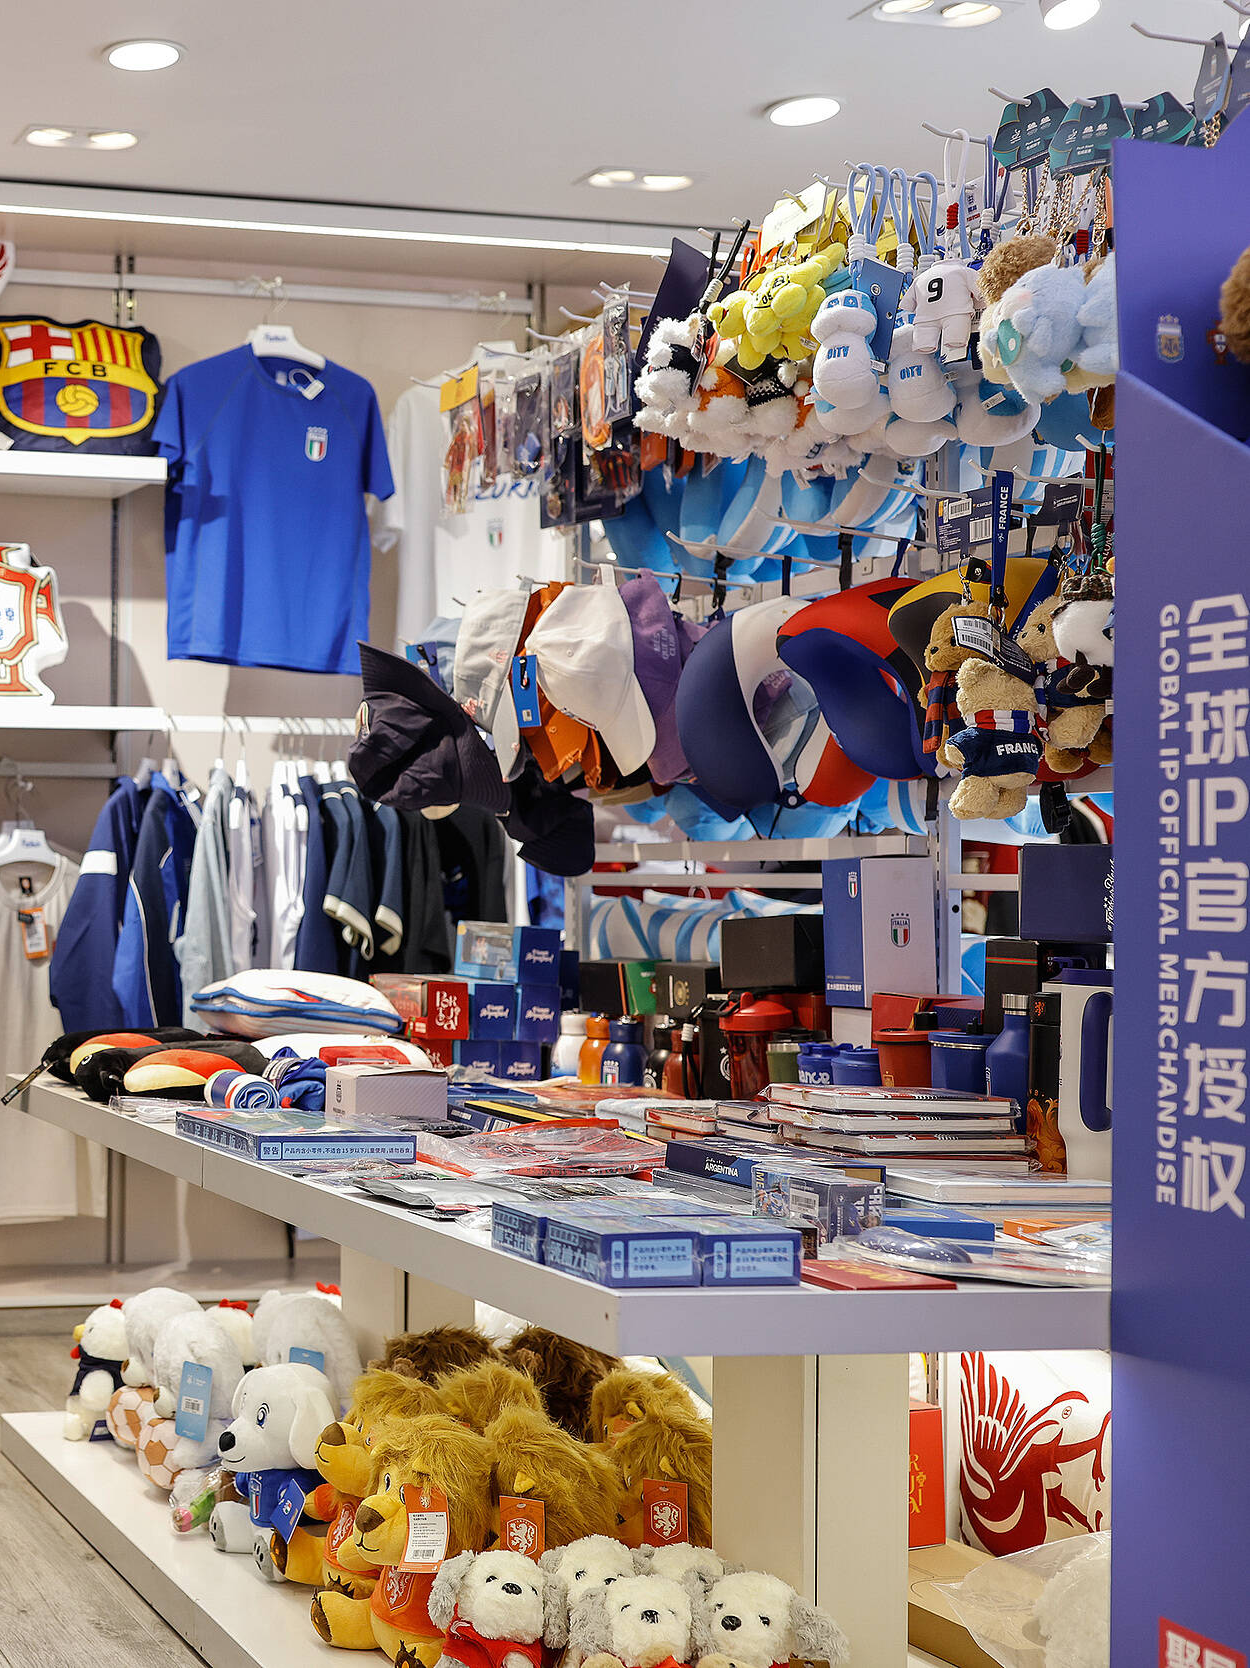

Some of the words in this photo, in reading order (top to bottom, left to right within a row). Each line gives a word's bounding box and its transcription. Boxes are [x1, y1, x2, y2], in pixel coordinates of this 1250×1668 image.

[928, 278, 944, 303] 9
[998, 486, 1010, 530] FRANCE
[1159, 603, 1181, 740] GLOBAL
[996, 741, 1039, 756] FRANC
[1159, 747, 1180, 781] IP
[1159, 787, 1180, 945] OFFICIAL
[1181, 593, 1250, 1219] 全球IP官方授权
[1156, 953, 1180, 1206] MERCHANDISE
[263, 1146, 280, 1155] 警告
[704, 1162, 739, 1178] ARGENTINA
